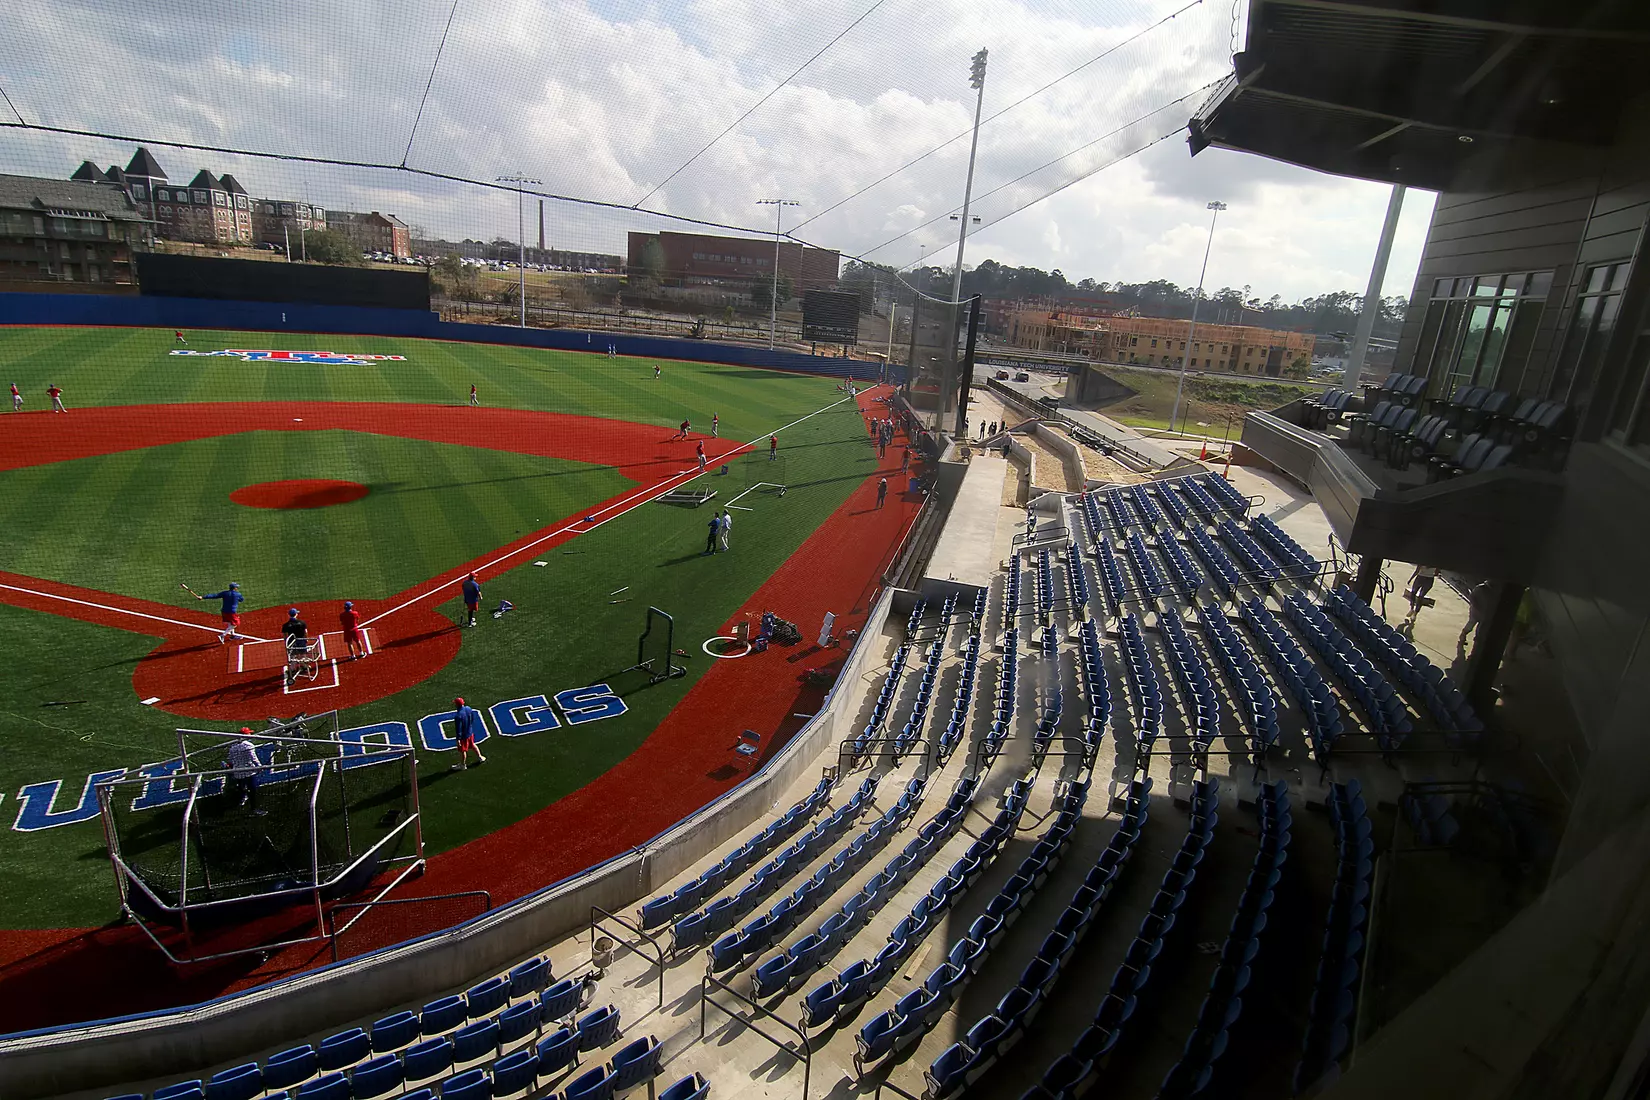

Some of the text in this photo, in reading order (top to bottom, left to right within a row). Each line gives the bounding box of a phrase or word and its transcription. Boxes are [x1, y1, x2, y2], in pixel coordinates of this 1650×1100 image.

[988, 359, 1019, 367] LOUISIANA
[1035, 364, 1069, 372] UNIVERSITY
[0, 683, 629, 832] ULLDOGS
